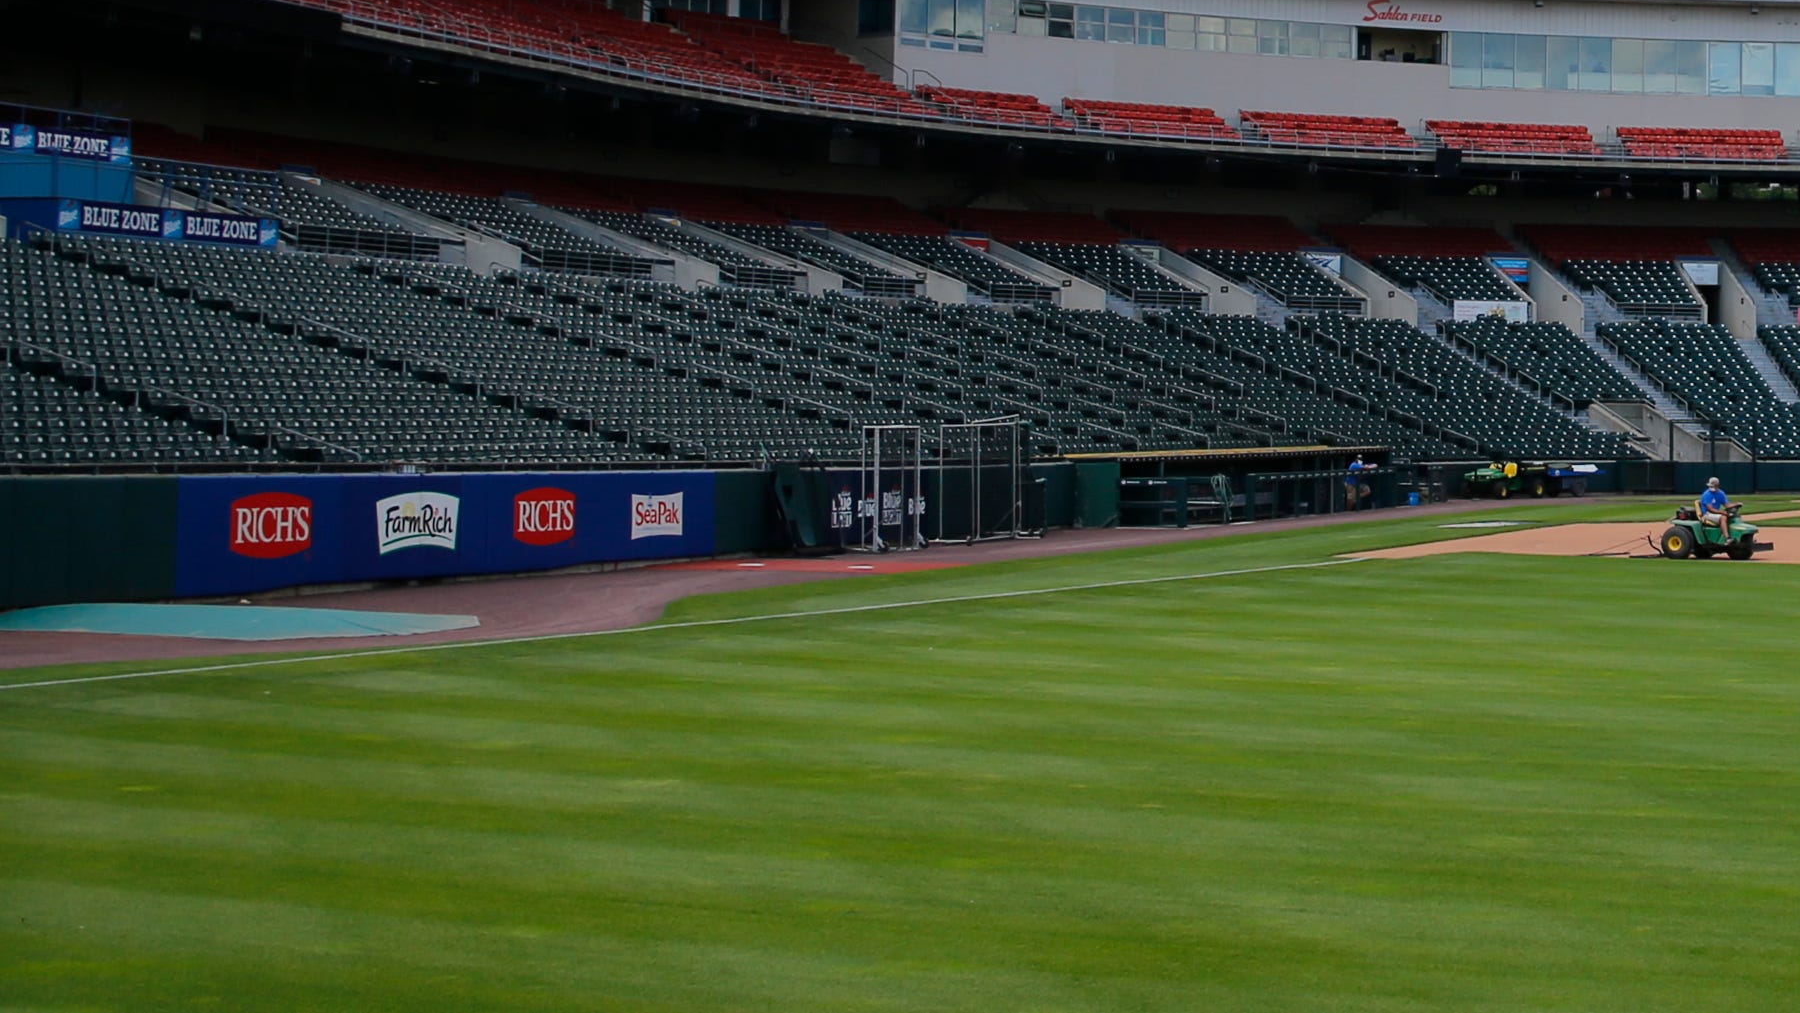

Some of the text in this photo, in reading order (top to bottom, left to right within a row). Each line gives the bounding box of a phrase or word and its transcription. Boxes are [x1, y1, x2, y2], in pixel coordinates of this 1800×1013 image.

[1410, 13, 1443, 23] FIELD
[38, 131, 72, 153] BLUE
[73, 136, 109, 157] ZONE
[82, 205, 160, 232] BLUE ZONE
[186, 216, 258, 240] BLUE ZONE
[234, 506, 310, 544] RICH'S
[517, 499, 574, 533] RICH'S
